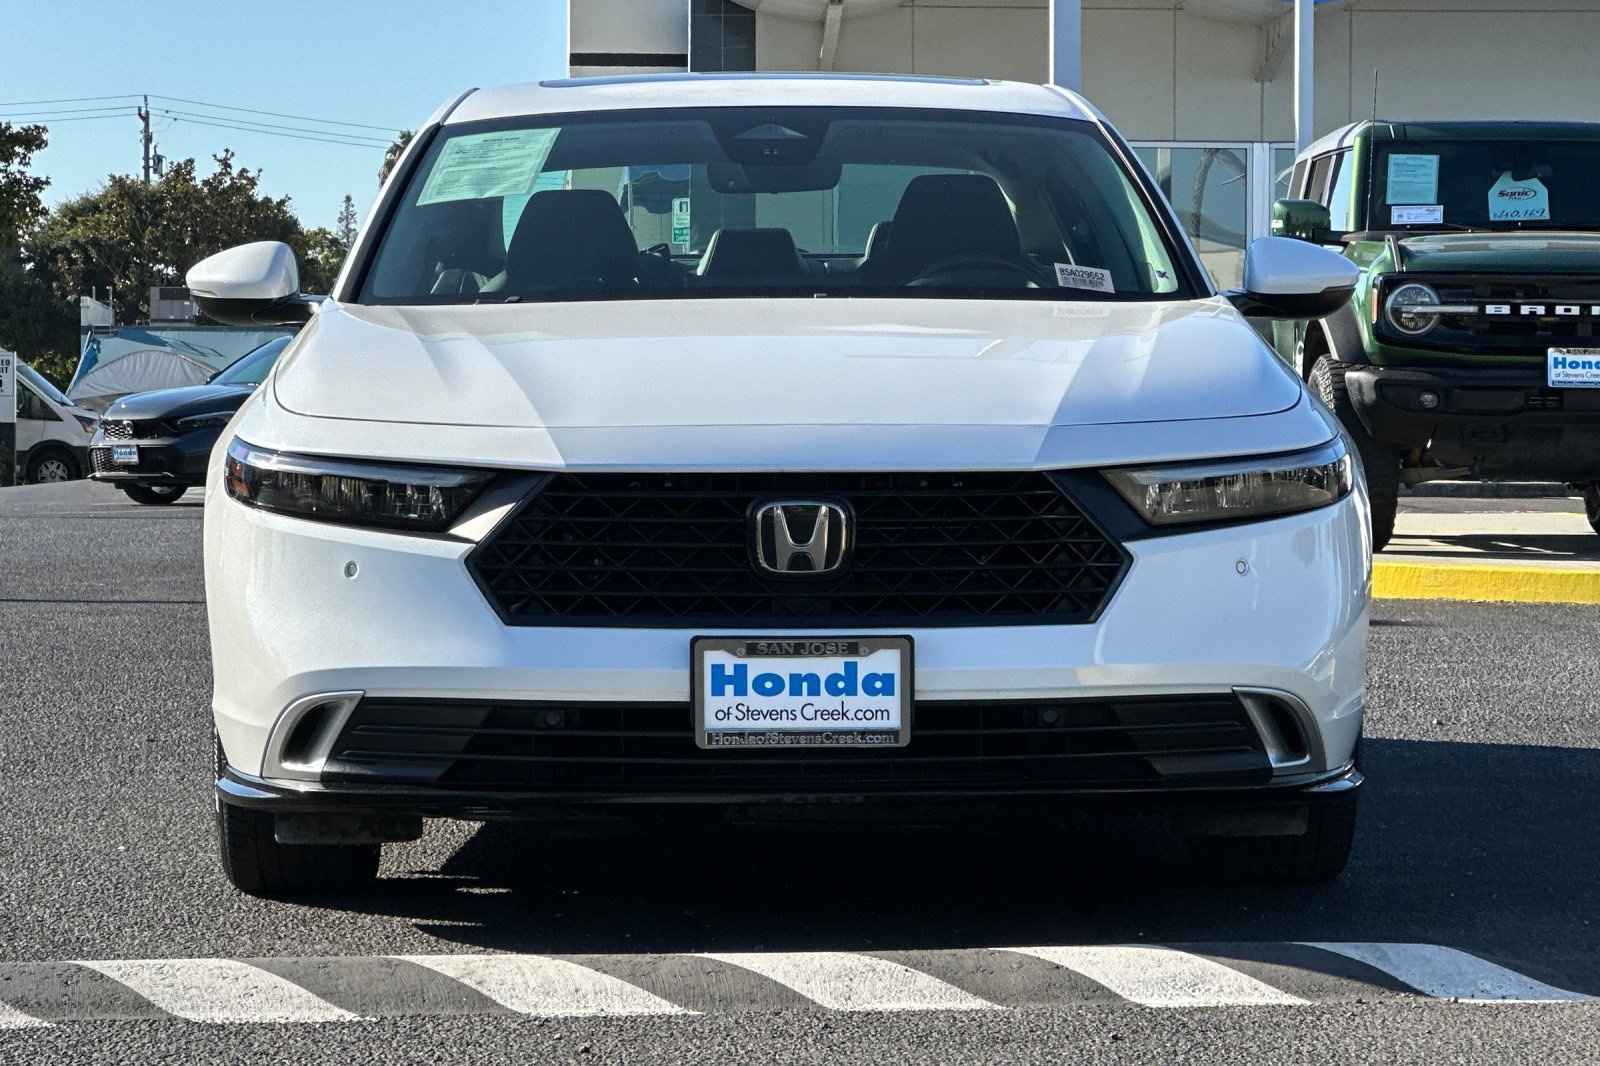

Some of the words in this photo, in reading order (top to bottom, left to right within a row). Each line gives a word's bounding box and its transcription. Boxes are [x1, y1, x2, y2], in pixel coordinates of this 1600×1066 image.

[1497, 188, 1532, 198] Sonic
[1059, 267, 1105, 281] BSA029652
[1561, 370, 1584, 379] Stevens
[113, 448, 137, 456] Honda
[756, 642, 796, 655] SAN
[802, 642, 848, 655] JOSE
[710, 661, 895, 697] Honda
[715, 705, 732, 721] of
[735, 702, 796, 721] Stevens
[800, 701, 890, 721] Creek.com
